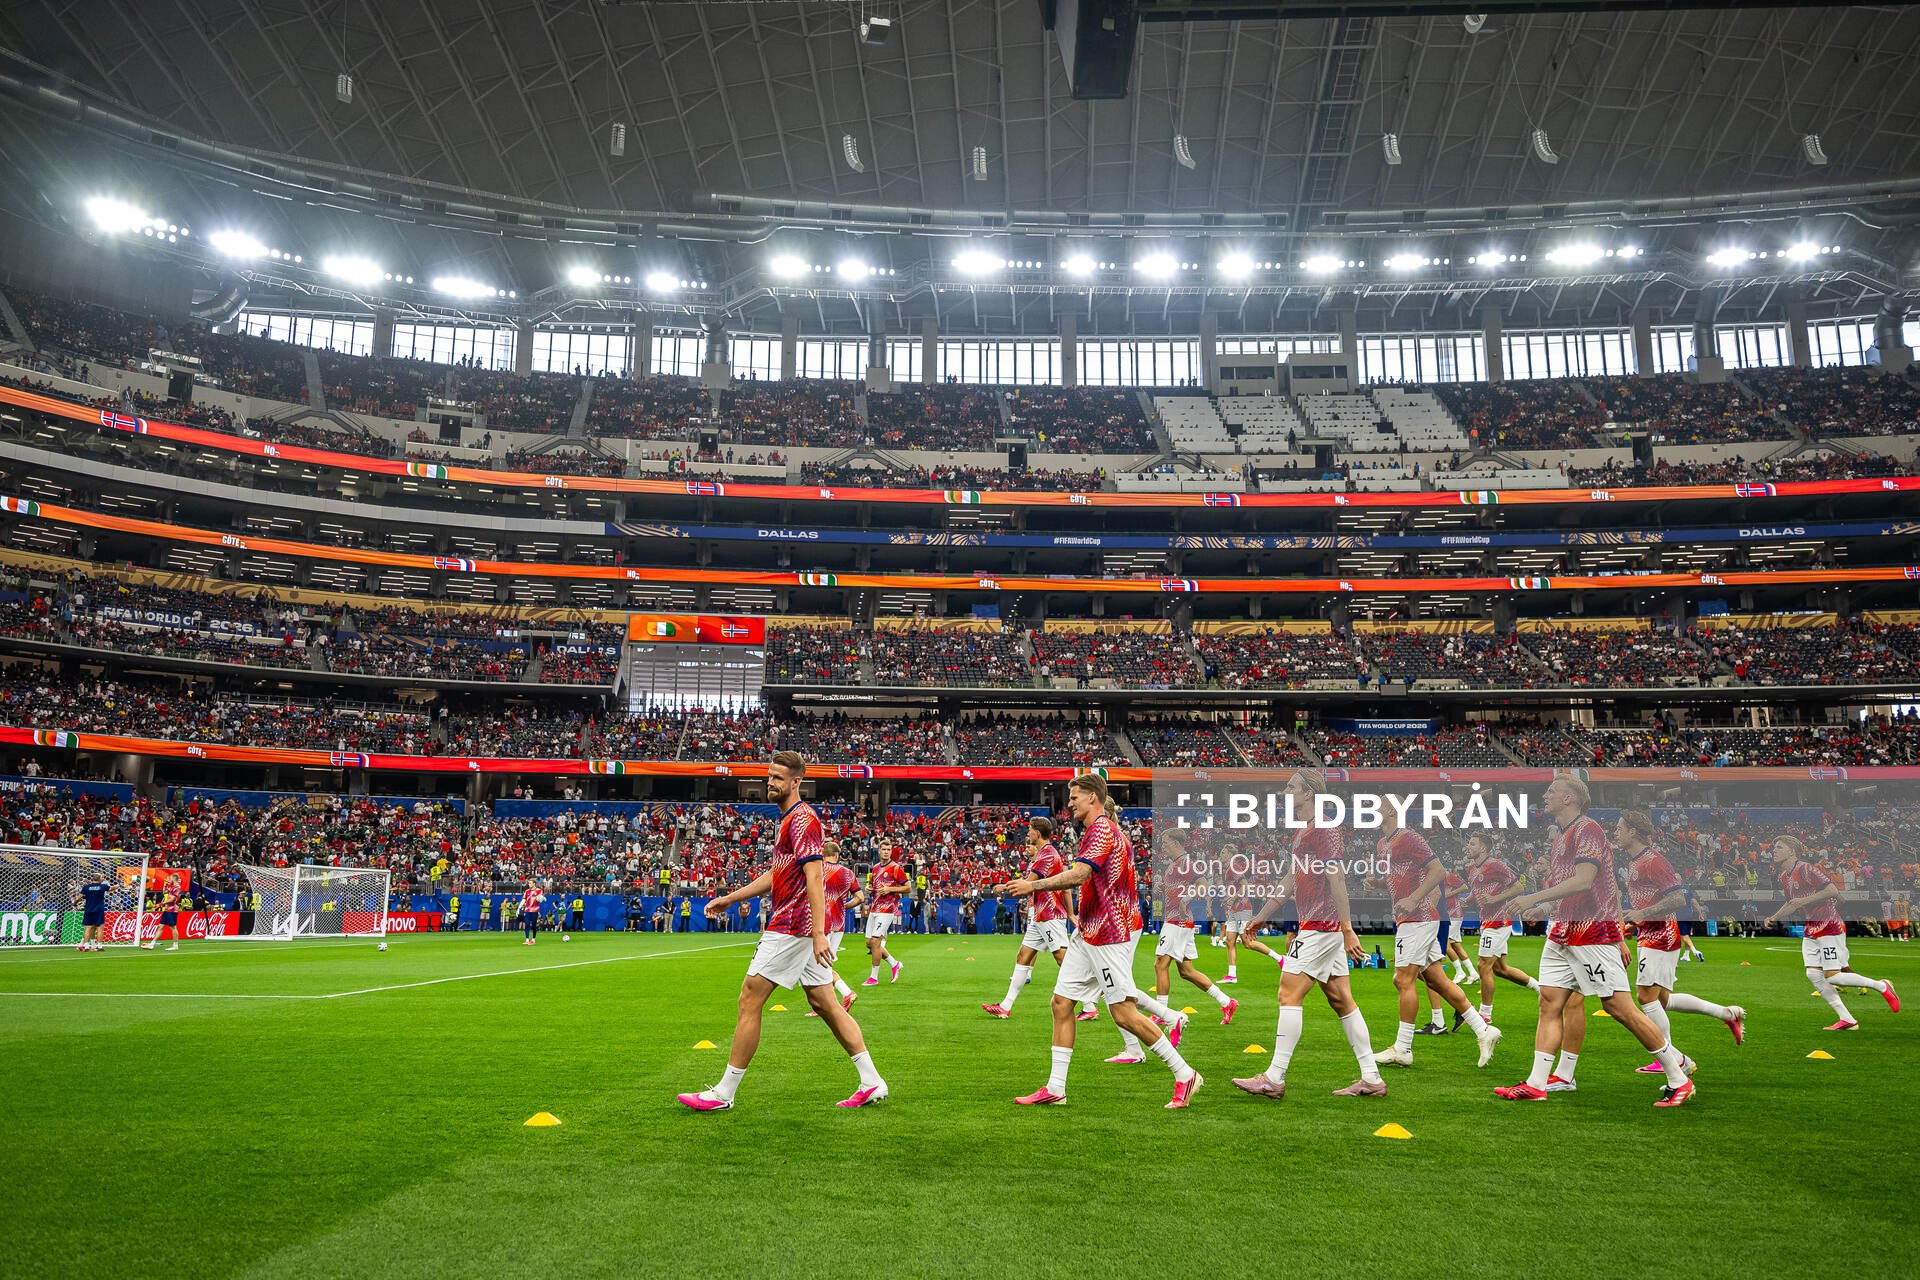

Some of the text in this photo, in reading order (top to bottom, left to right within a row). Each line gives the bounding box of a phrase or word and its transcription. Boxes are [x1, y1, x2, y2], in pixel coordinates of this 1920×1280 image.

[758, 530, 818, 539] DALLAS
[1739, 527, 1805, 537] DALLAS
[1054, 537, 1101, 546] #FIFAWorldCup
[1441, 536, 1490, 545] #FIFAWorldCup
[1046, 930, 1053, 943] 8
[1482, 936, 1492, 949] 15
[1396, 939, 1404, 955] 4
[1823, 947, 1837, 960] 23
[1102, 968, 1115, 988] 5
